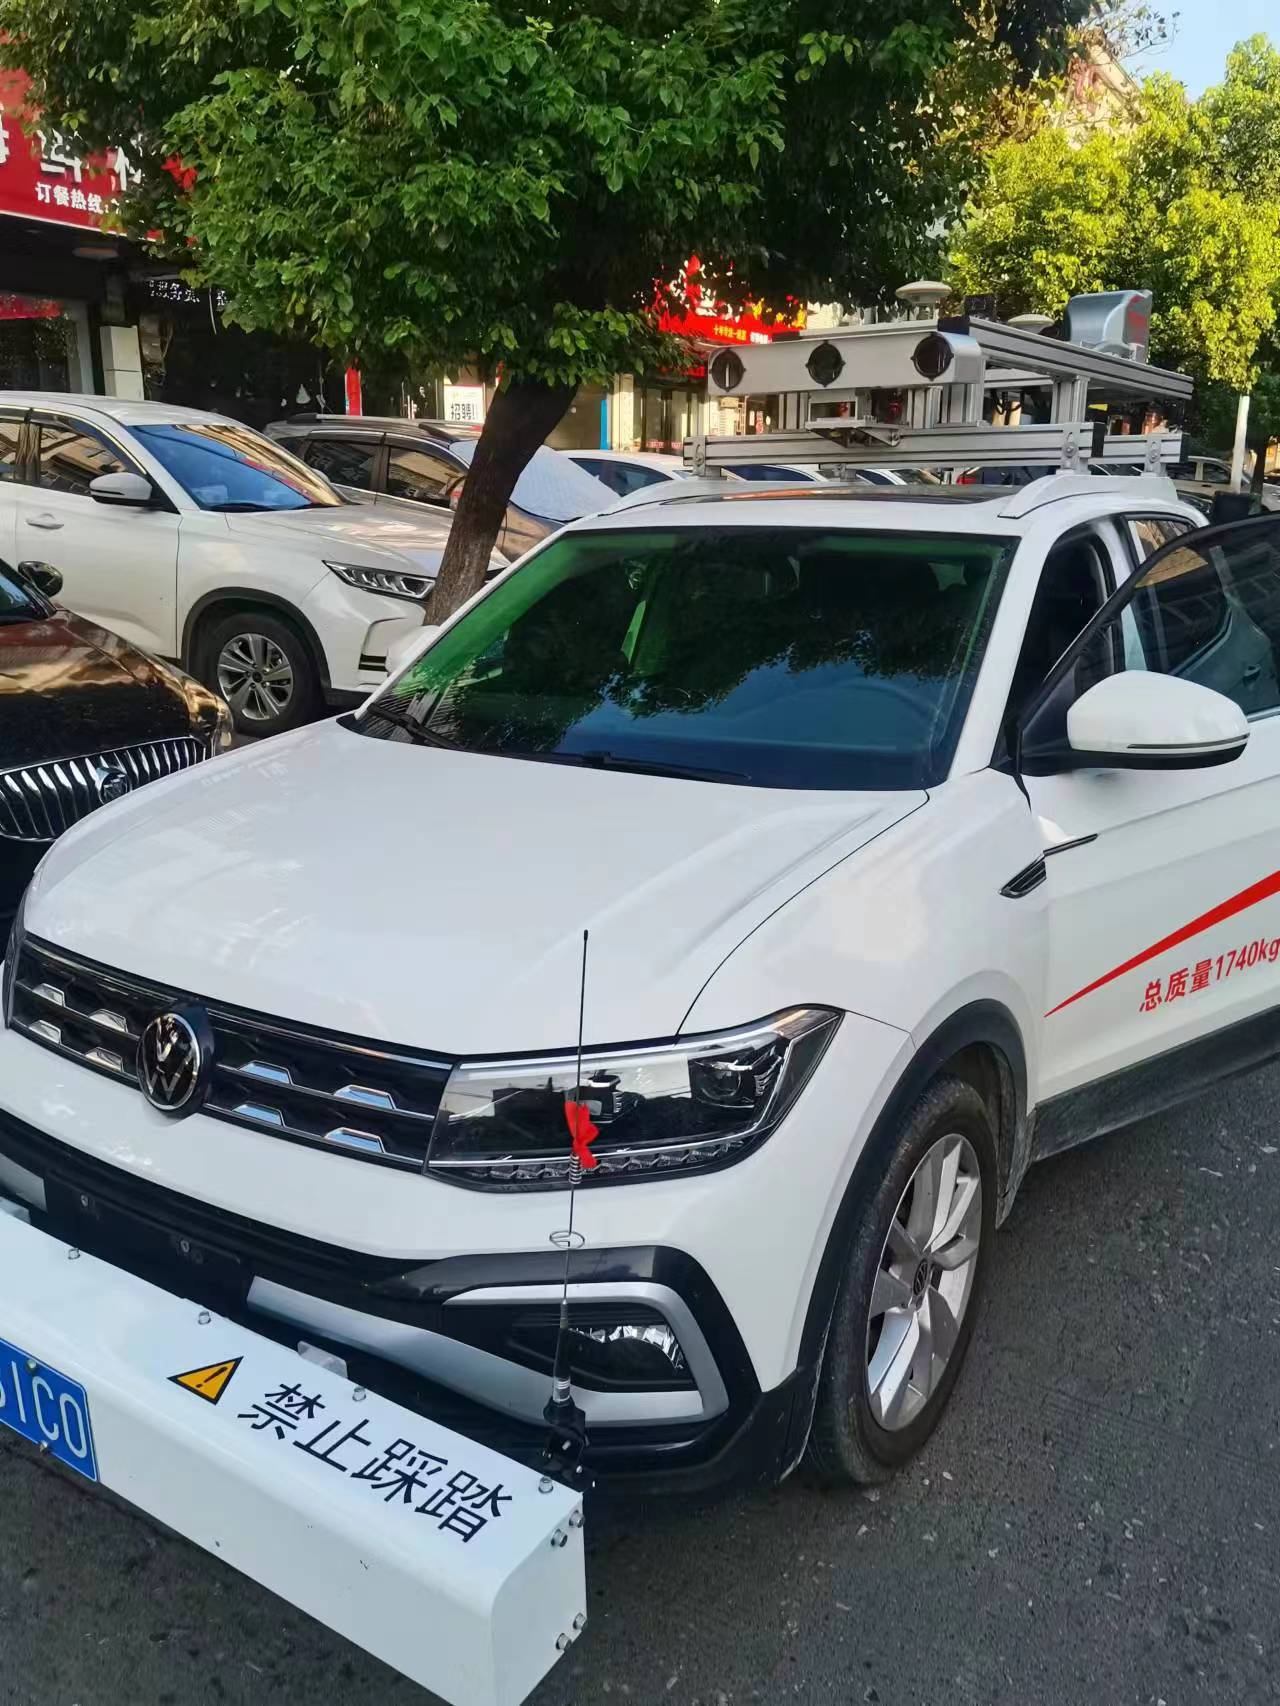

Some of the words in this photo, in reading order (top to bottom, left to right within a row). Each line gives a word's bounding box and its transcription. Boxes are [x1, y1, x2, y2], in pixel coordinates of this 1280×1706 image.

[1139, 938, 1280, 1012] 总质量1740kg
[237, 1382, 513, 1543] 禁止踩踏
